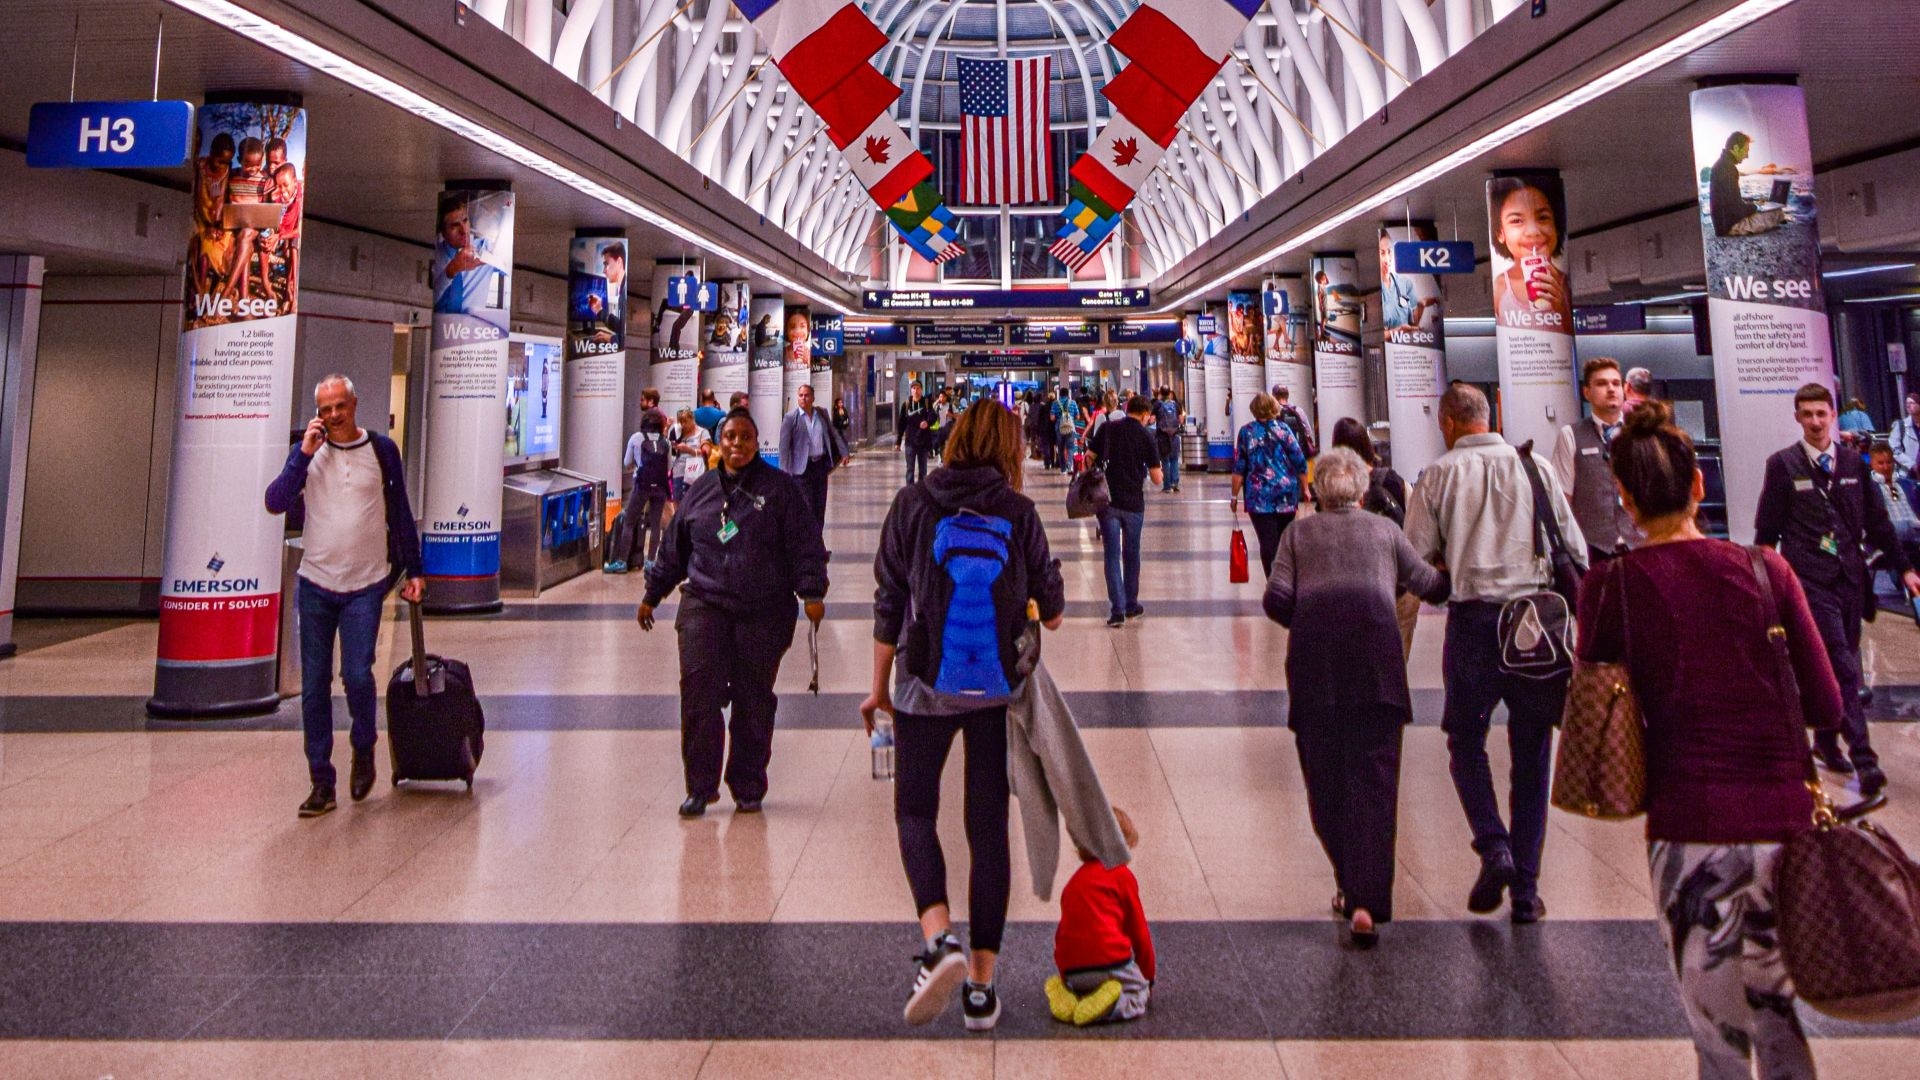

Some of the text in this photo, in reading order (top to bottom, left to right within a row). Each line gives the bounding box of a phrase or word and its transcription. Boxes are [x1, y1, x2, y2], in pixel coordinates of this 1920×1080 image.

[79, 117, 135, 153] H3
[1420, 248, 1450, 268] K2
[1724, 276, 1812, 300] We see
[195, 293, 278, 317] We see
[1504, 310, 1562, 326] We see
[1742, 313, 1774, 322] offshore
[442, 323, 500, 340] We see
[1734, 322, 1768, 332] platforms
[1770, 322, 1792, 331] being
[252, 330, 274, 338] billion
[1390, 330, 1434, 344] We see
[1735, 331, 1806, 340] from the safety and
[250, 340, 274, 348] people
[575, 340, 618, 354] We see
[824, 340, 834, 350] G
[1317, 341, 1352, 352] We see
[1736, 340, 1808, 350] comfort of dry land.
[214, 348, 240, 358] having
[658, 348, 694, 358] We see
[1269, 350, 1282, 359] We
[213, 358, 274, 368] and clean power.
[718, 354, 735, 363] We
[754, 358, 768, 368] We
[204, 383, 230, 391] existing
[252, 382, 272, 390] plants
[434, 521, 491, 531] EMERSON
[472, 534, 497, 542] SOLVED
[174, 578, 259, 592] EMERSON
[164, 598, 270, 611] CONSIDER IT SOLVED
